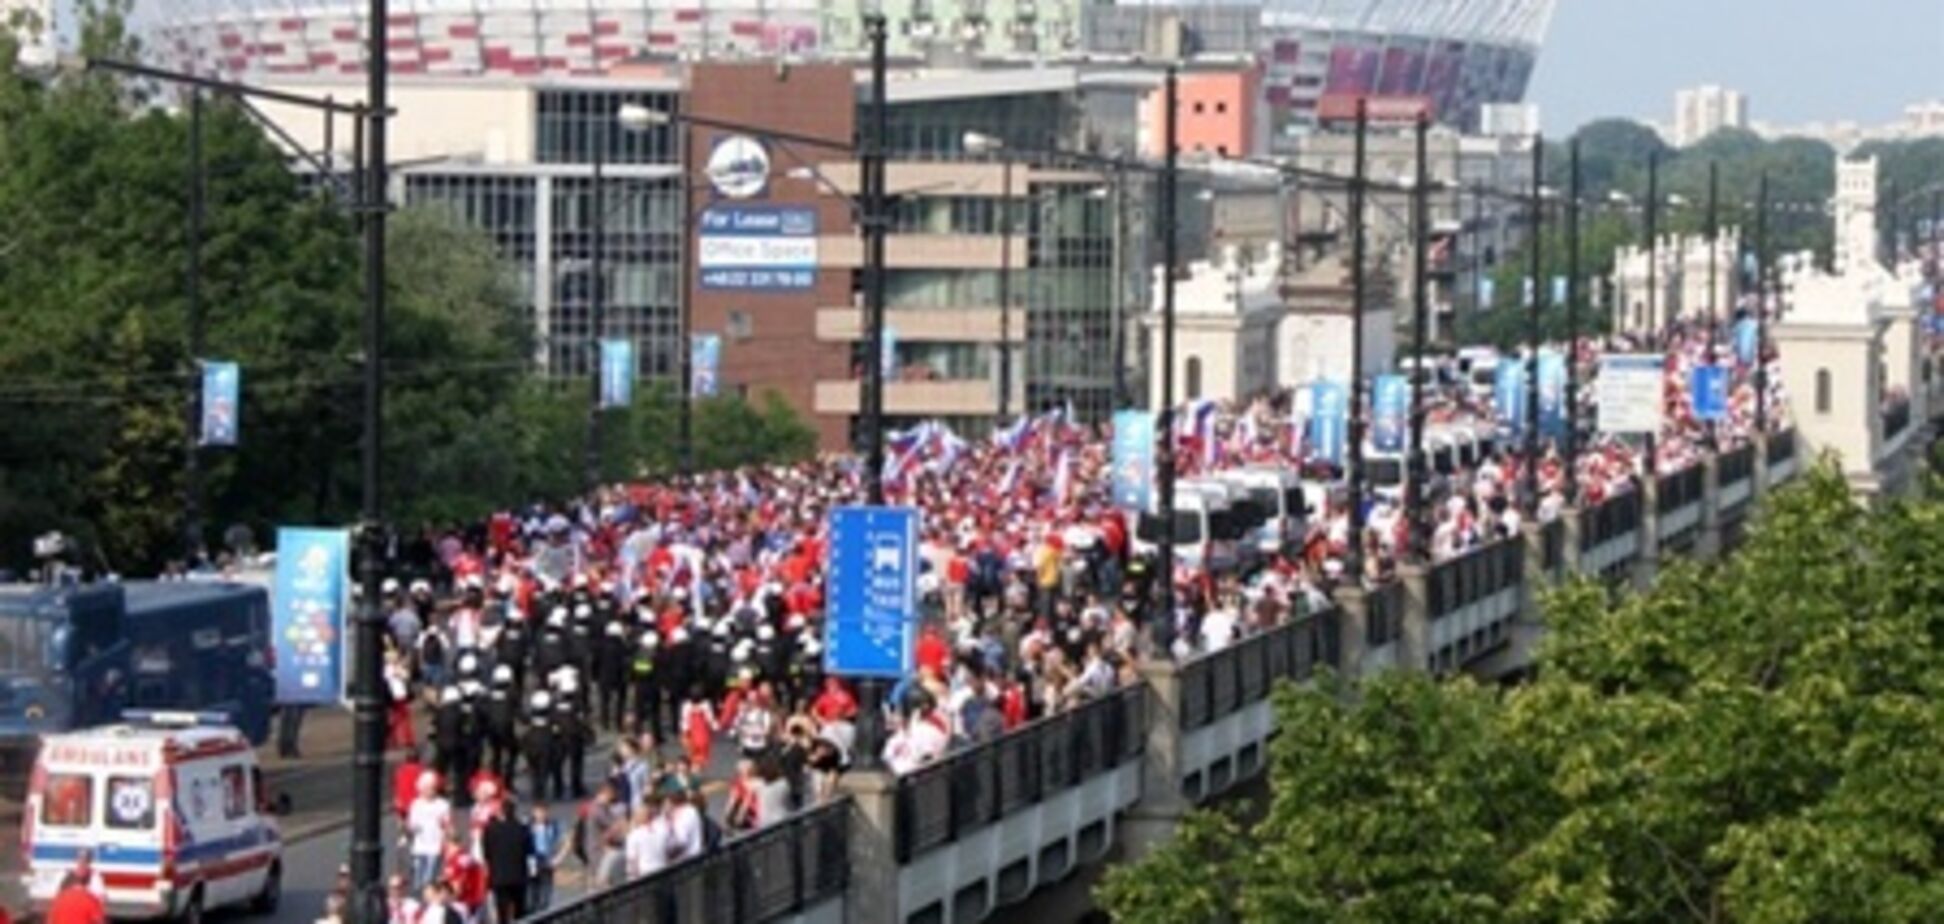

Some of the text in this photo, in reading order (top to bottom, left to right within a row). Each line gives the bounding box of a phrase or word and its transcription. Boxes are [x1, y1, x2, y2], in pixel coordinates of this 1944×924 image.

[702, 211, 729, 228] For
[733, 211, 780, 229] Lease
[703, 241, 811, 261] Office Space
